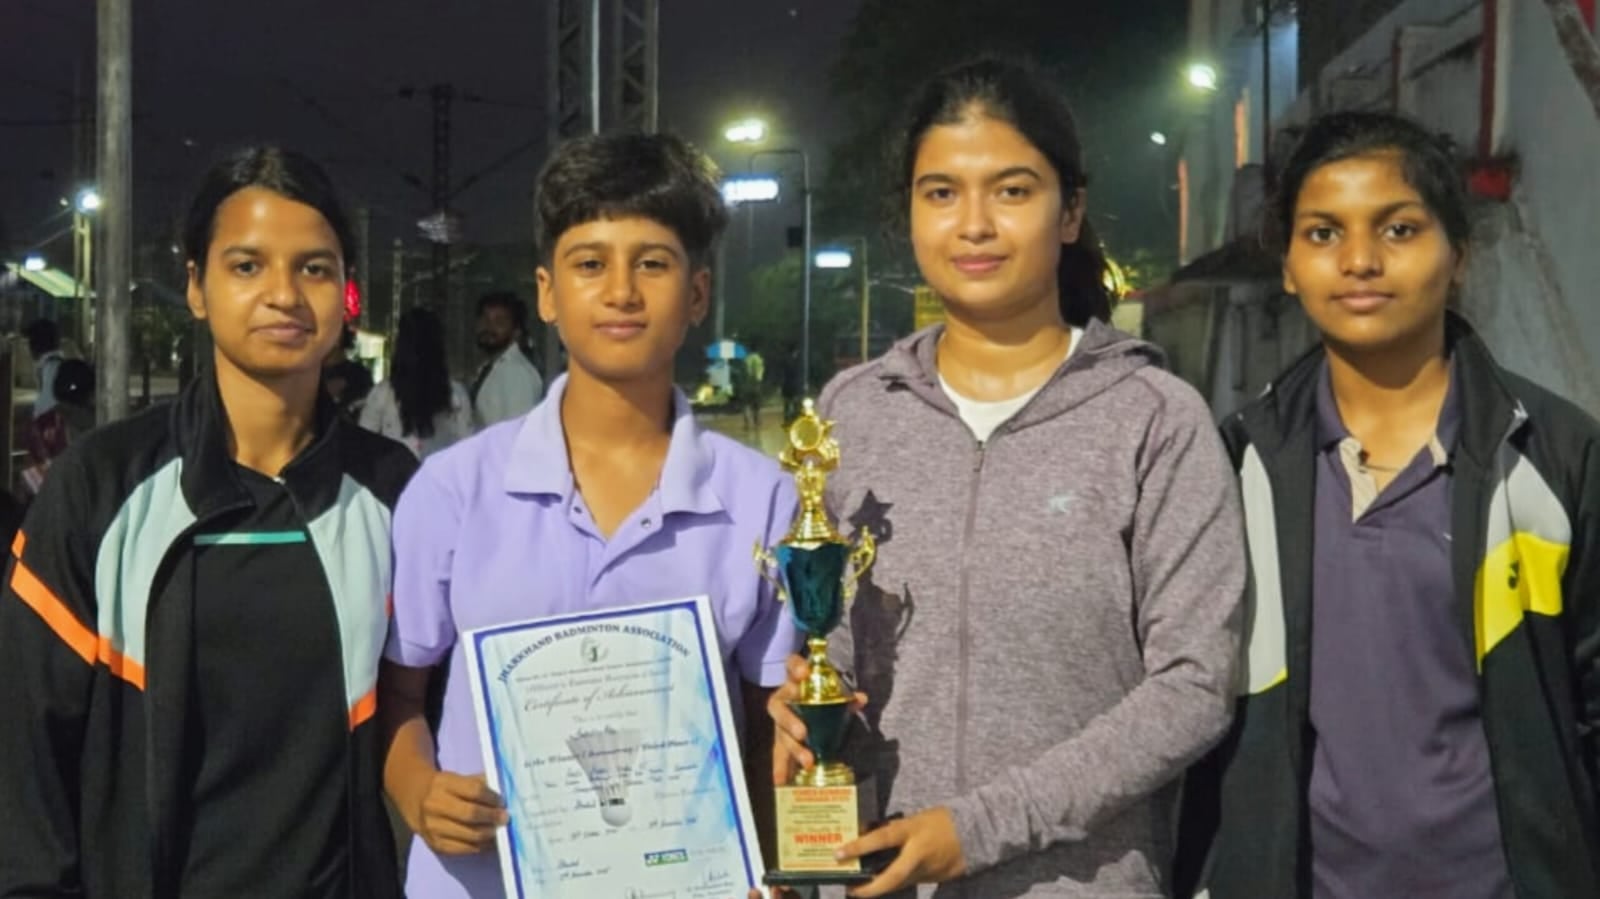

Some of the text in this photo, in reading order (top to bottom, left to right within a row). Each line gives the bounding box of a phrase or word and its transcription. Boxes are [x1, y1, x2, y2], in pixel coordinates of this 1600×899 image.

[498, 636, 553, 683] JHARKHAND
[554, 624, 620, 639] BADMINTON
[622, 625, 690, 656] ASSOCIATION
[793, 832, 843, 844] WINNER
